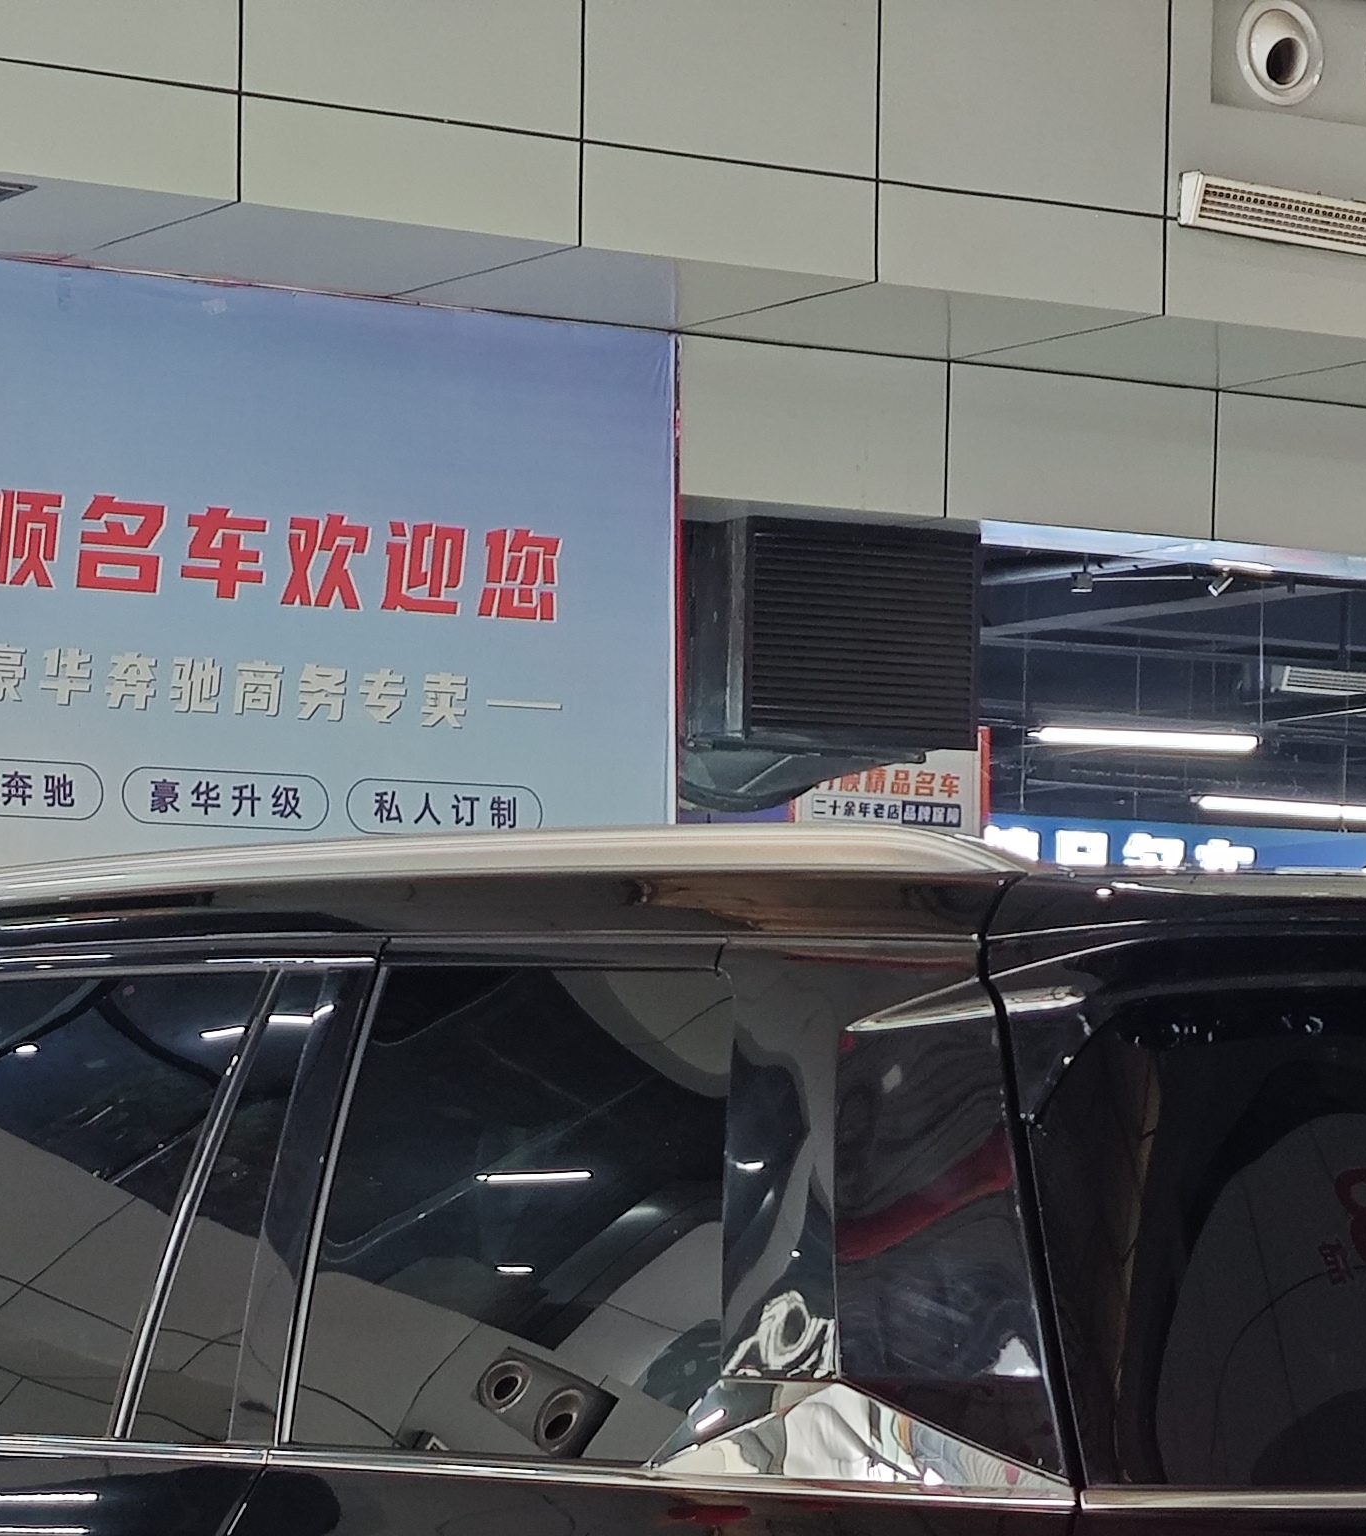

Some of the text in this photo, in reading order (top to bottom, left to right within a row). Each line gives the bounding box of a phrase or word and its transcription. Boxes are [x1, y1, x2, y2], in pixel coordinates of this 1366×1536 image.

[148, 777, 304, 822] 豪华升级
[373, 789, 519, 830] 私人订制
[815, 800, 900, 820] 二十余年老店
